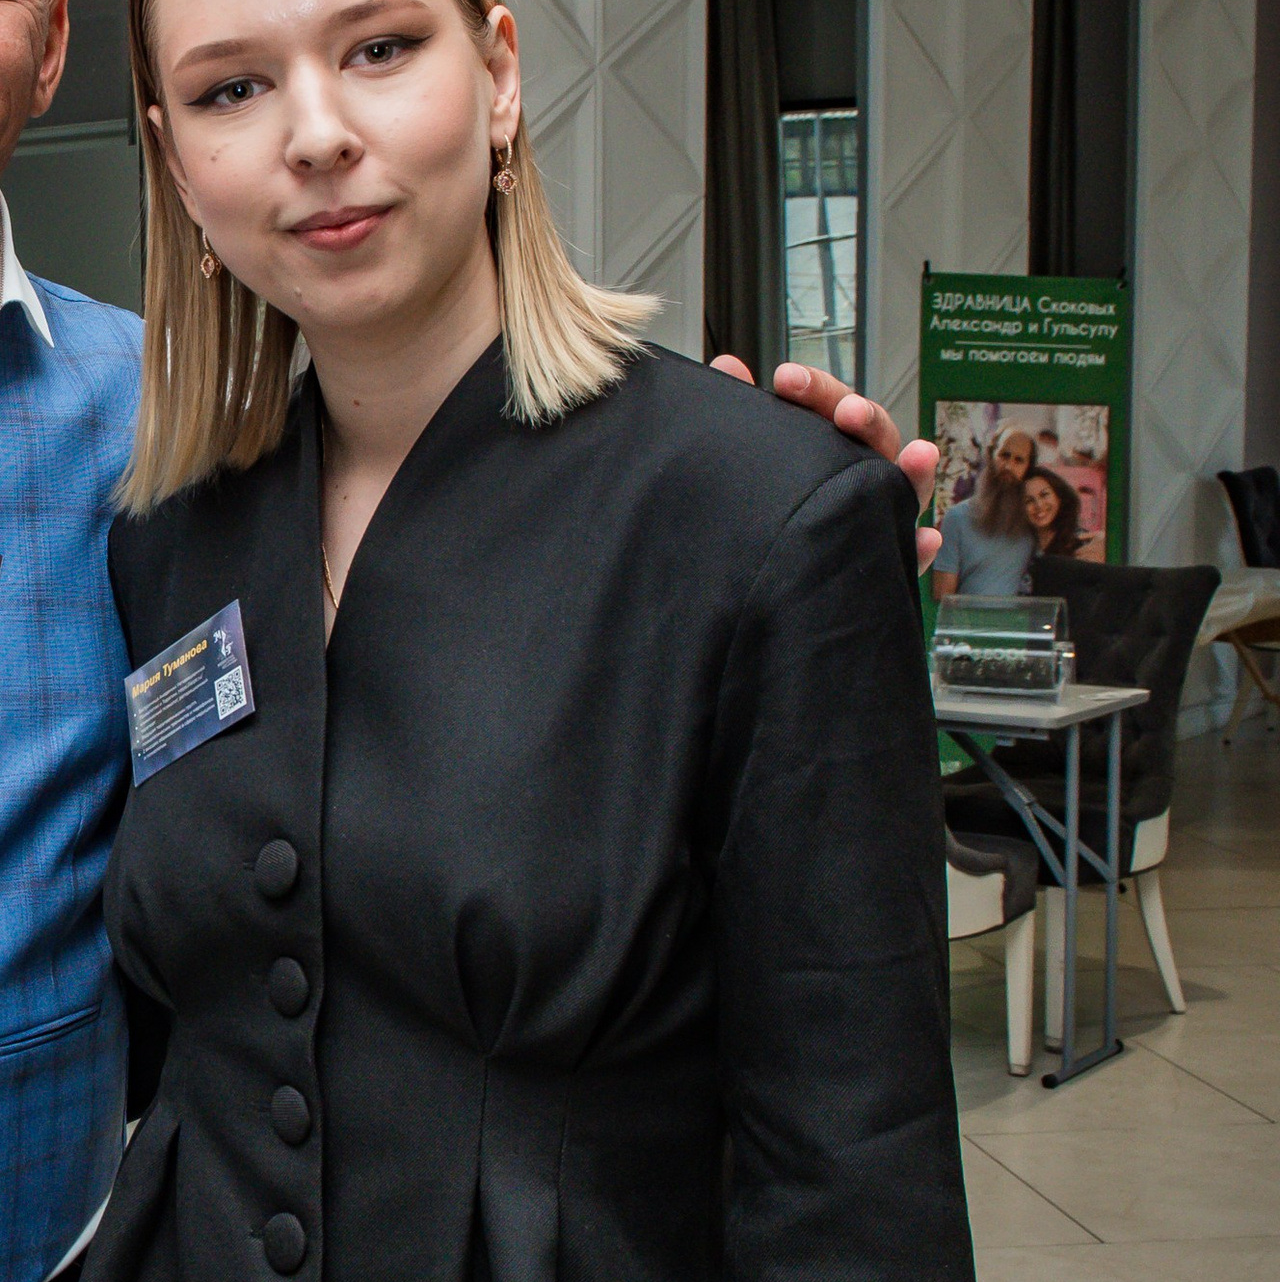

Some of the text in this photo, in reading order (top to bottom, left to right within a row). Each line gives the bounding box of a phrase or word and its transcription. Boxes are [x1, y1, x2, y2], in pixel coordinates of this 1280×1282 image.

[932, 292, 1117, 316] ЗДРАВНИЦА Скоковых
[930, 314, 1023, 335] Александр
[1028, 323, 1039, 334] и
[940, 348, 1106, 368] мы помогаем людям
[132, 671, 161, 699] Мария
[163, 639, 208, 678] Туманова
